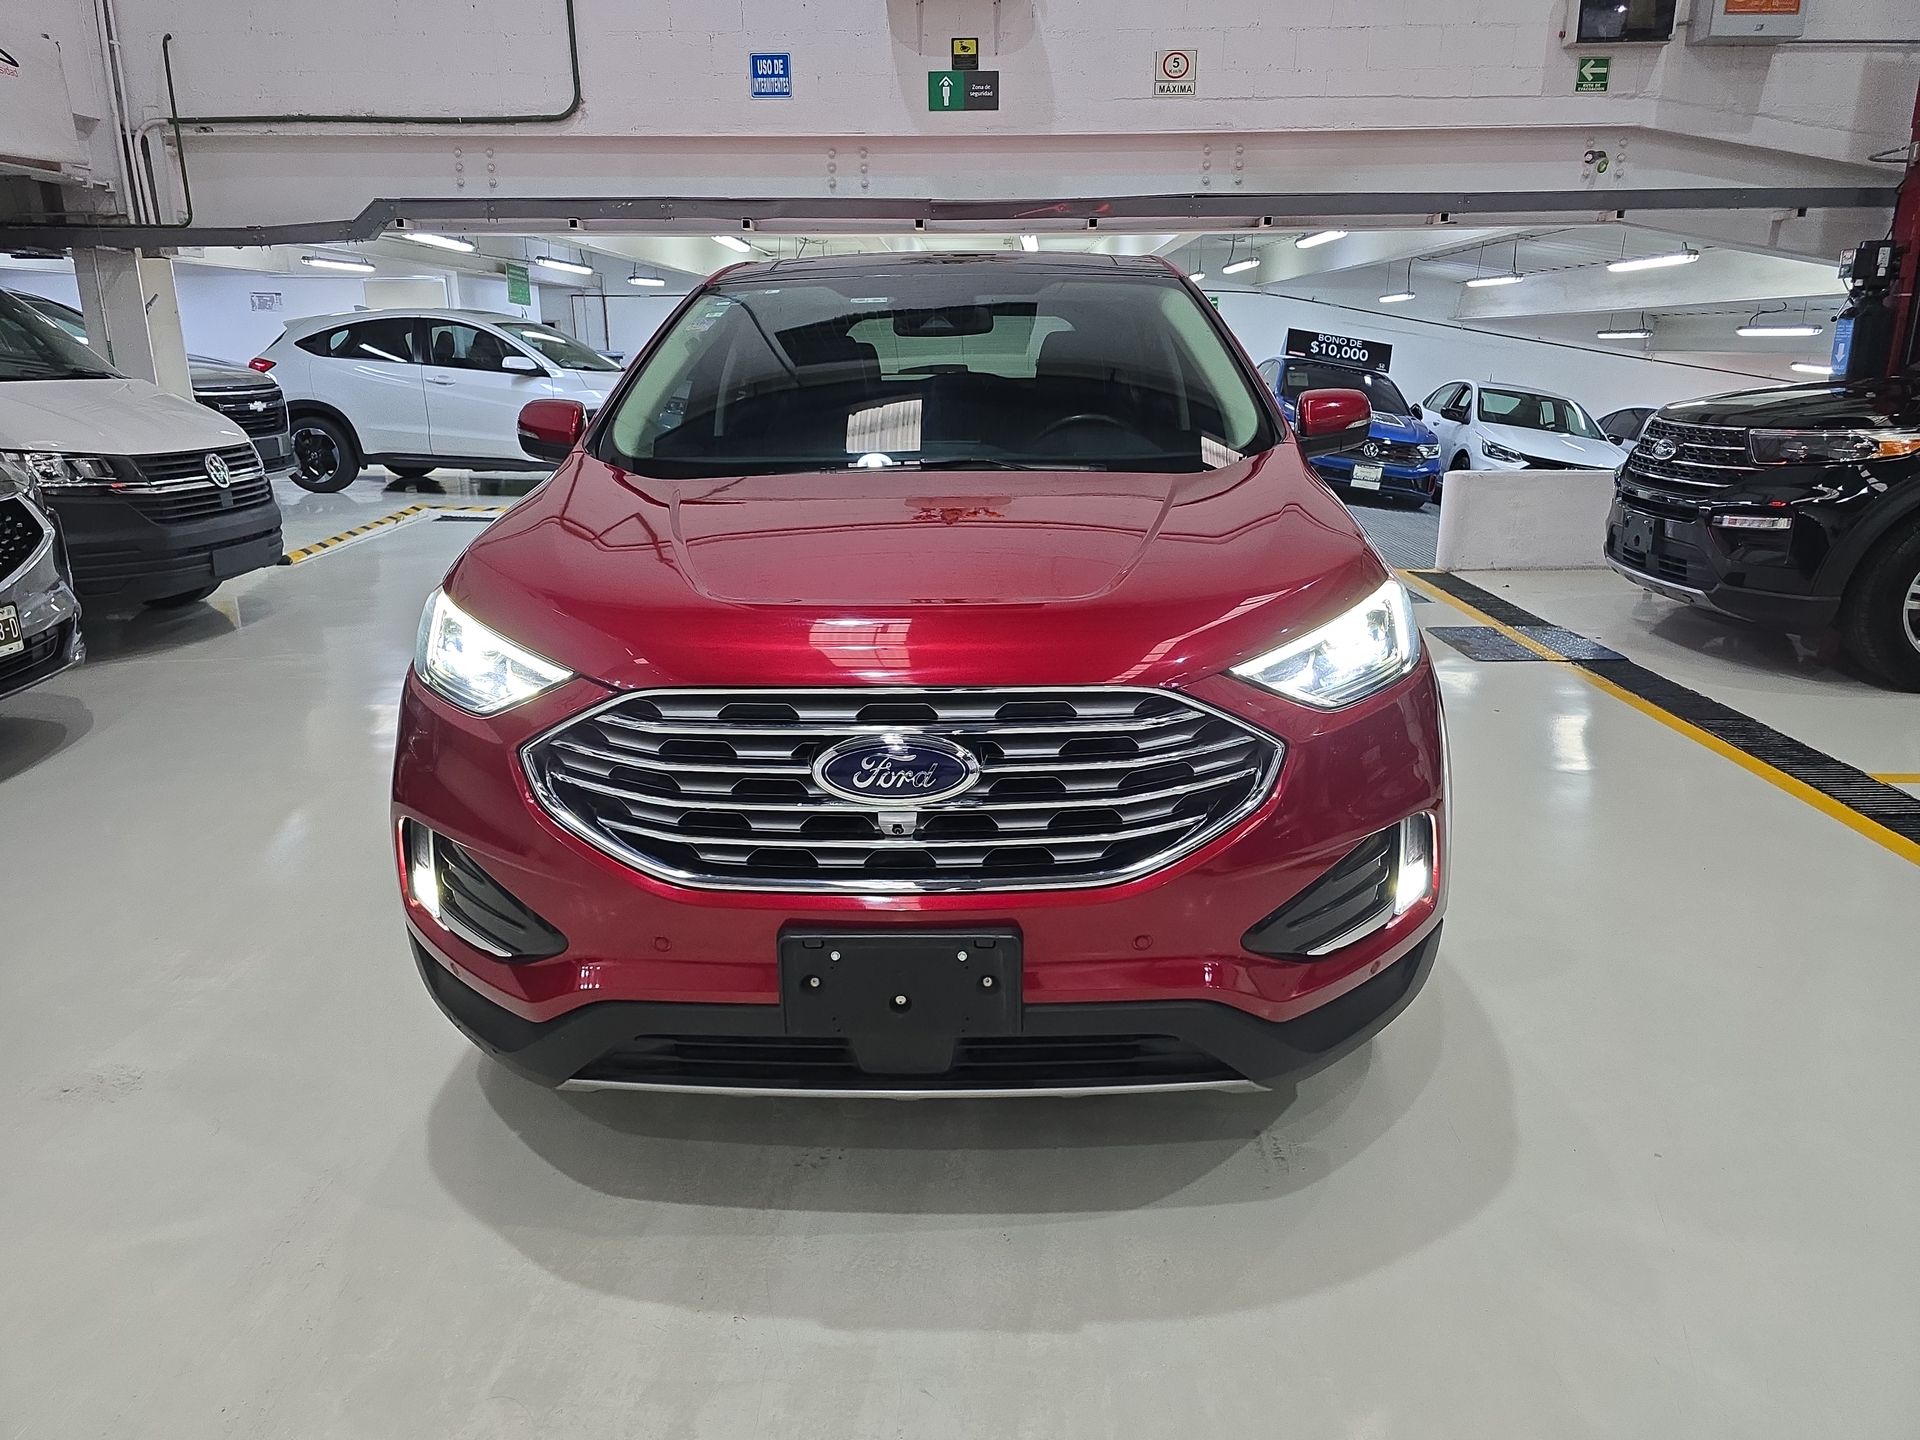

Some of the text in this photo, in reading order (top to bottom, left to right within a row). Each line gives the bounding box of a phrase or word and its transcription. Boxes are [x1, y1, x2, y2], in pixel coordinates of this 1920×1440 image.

[757, 59, 784, 75] USO DE
[1172, 57, 1180, 68] 5
[969, 90, 993, 98] seguridad
[1158, 83, 1193, 93] MÁXIMA
[1318, 333, 1363, 348] BONO DE
[1310, 340, 1369, 362] $10,000
[852, 752, 939, 789] Ford
